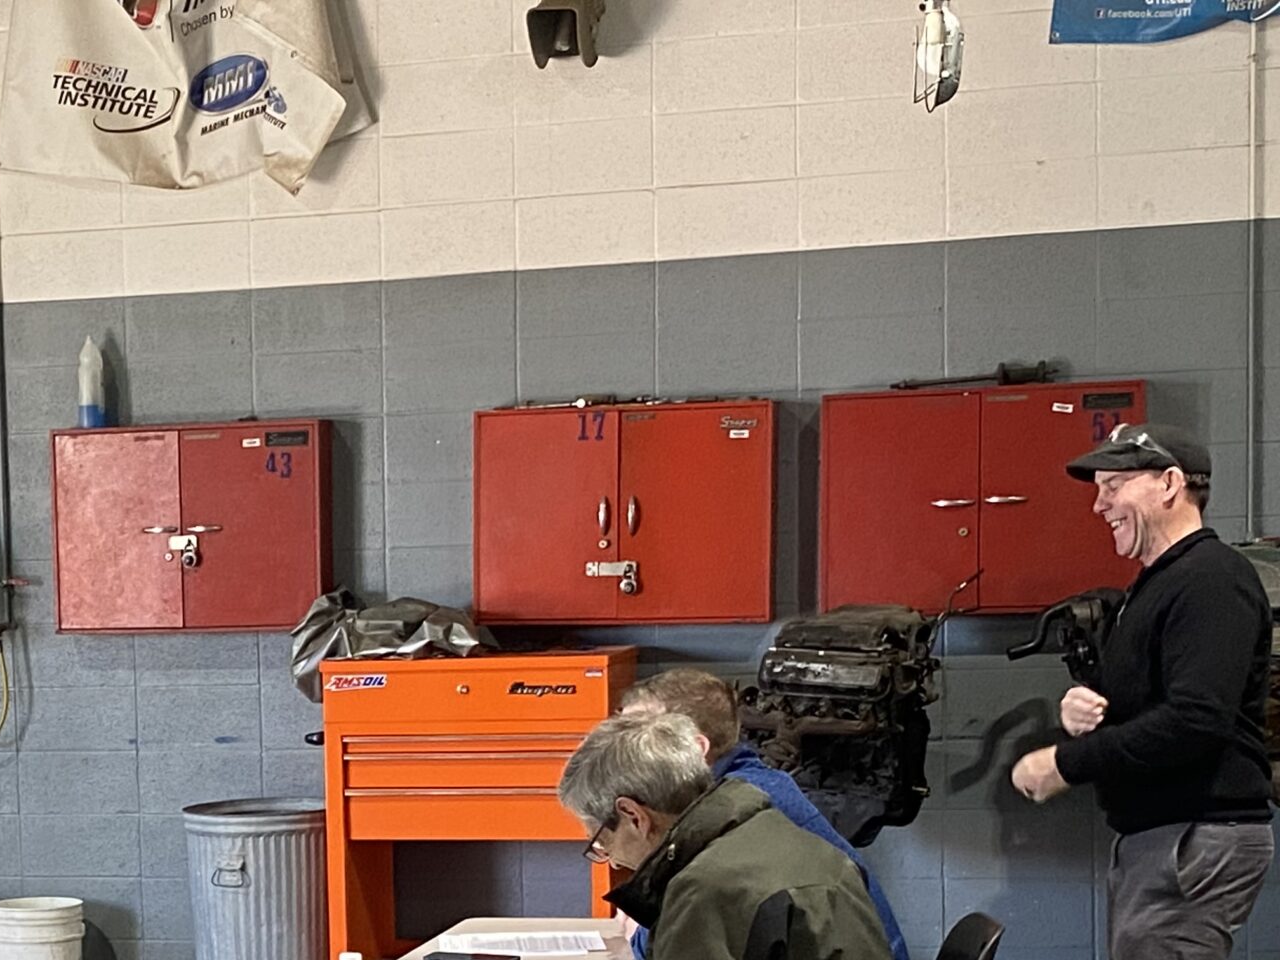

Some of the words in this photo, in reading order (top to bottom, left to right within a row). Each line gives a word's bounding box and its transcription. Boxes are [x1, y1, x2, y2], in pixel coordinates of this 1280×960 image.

[180, 10, 217, 37] Chosen
[220, 4, 235, 20] by
[76, 60, 129, 84] NASCAR
[202, 60, 258, 106] MMI
[52, 74, 159, 105] TECHNICAL
[58, 90, 158, 119] INSTITUTE
[200, 117, 230, 136] MARINE
[577, 409, 607, 441] 17
[265, 451, 293, 479] 43
[329, 676, 385, 689] AMSOIL
